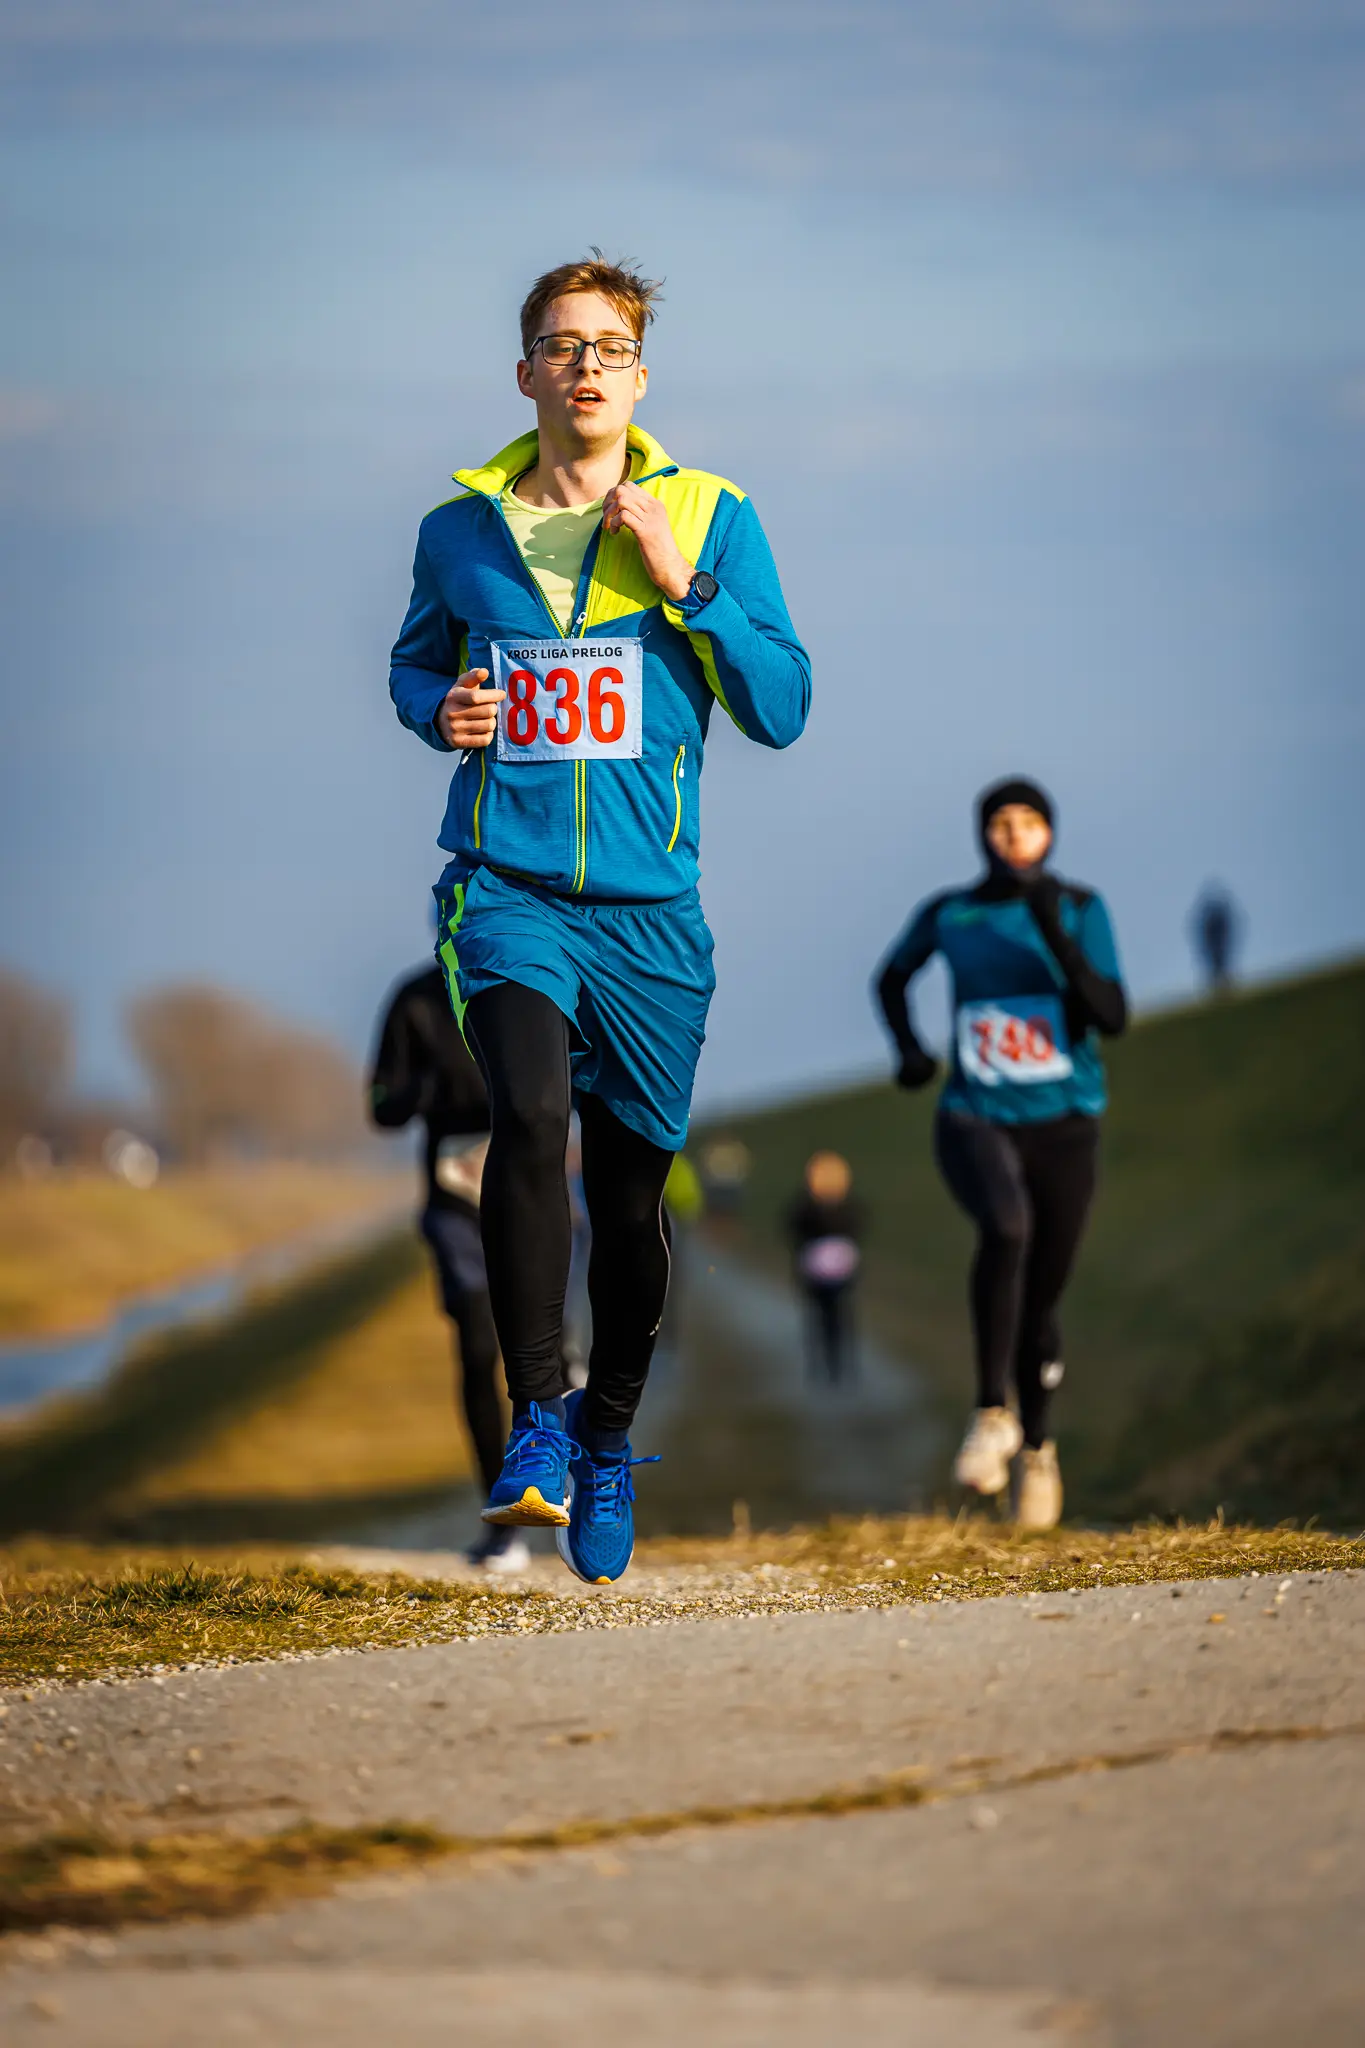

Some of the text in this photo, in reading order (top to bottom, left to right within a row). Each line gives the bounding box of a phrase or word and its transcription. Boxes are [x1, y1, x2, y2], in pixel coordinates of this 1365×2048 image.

[507, 646, 623, 660] KROS LIGA PRELOG
[507, 666, 626, 747] 836
